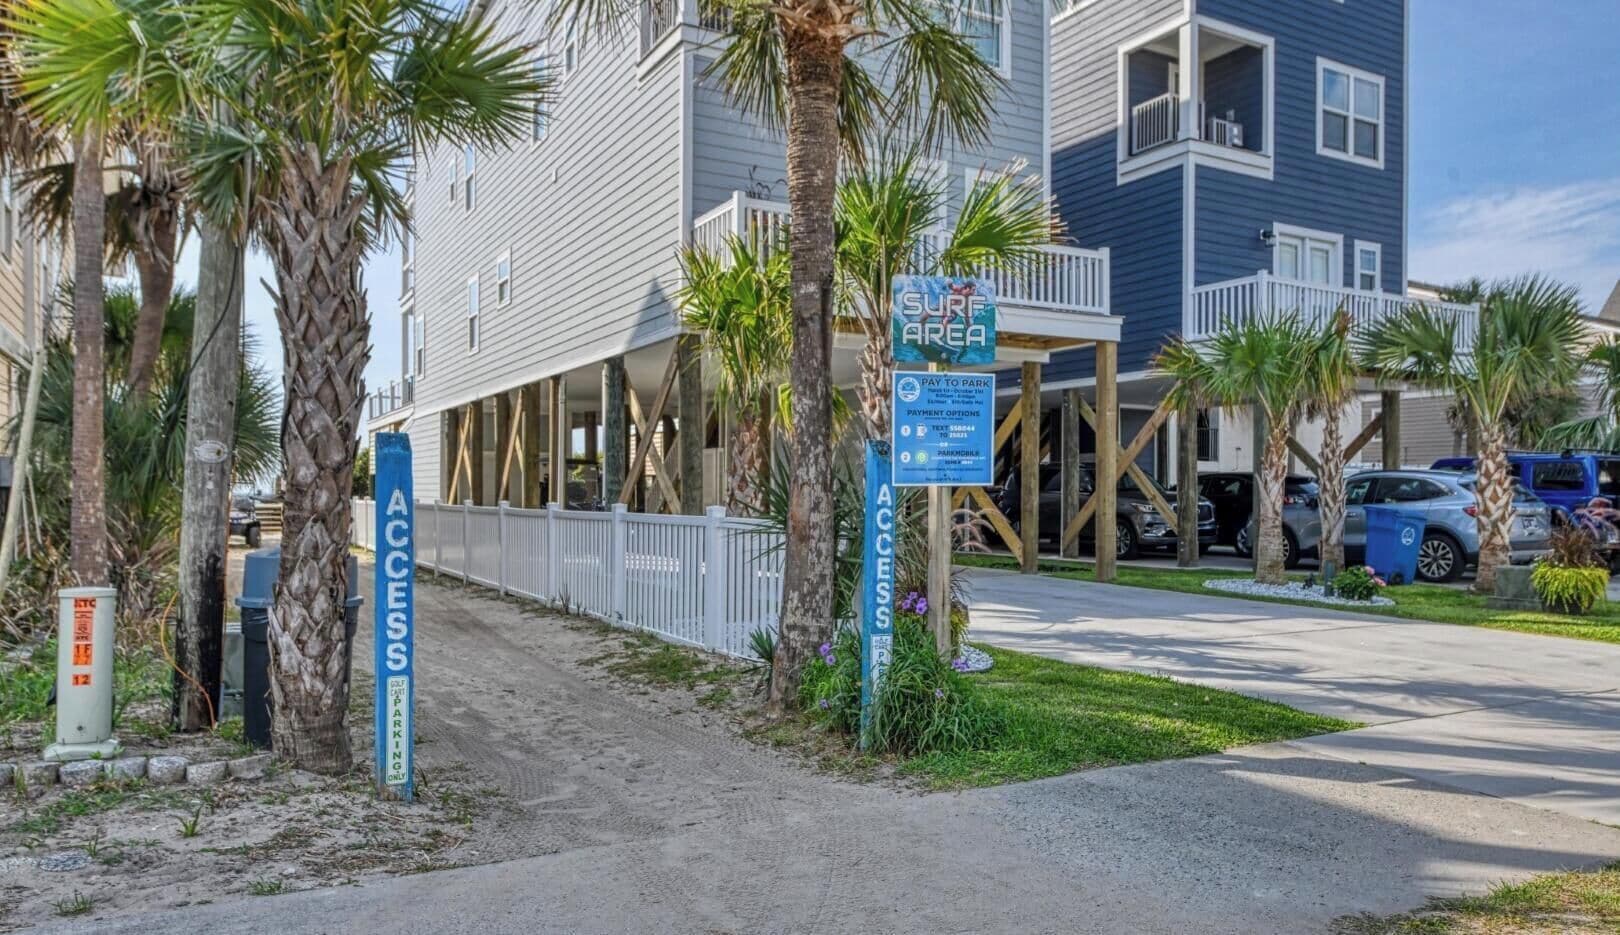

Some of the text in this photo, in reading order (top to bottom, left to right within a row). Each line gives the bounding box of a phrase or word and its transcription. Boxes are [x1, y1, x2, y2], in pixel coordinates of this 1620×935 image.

[903, 292, 987, 317] SURF
[902, 322, 986, 347] AREA
[921, 378, 941, 386] PAY
[962, 380, 990, 388] PARK
[906, 409, 943, 417] PAYMENT
[876, 483, 893, 629] ACCESS
[384, 488, 409, 671] ACCESS
[74, 674, 89, 685] 12
[390, 679, 406, 688] GOLF
[392, 698, 402, 771] PARKING
[388, 774, 406, 782] ONLY
